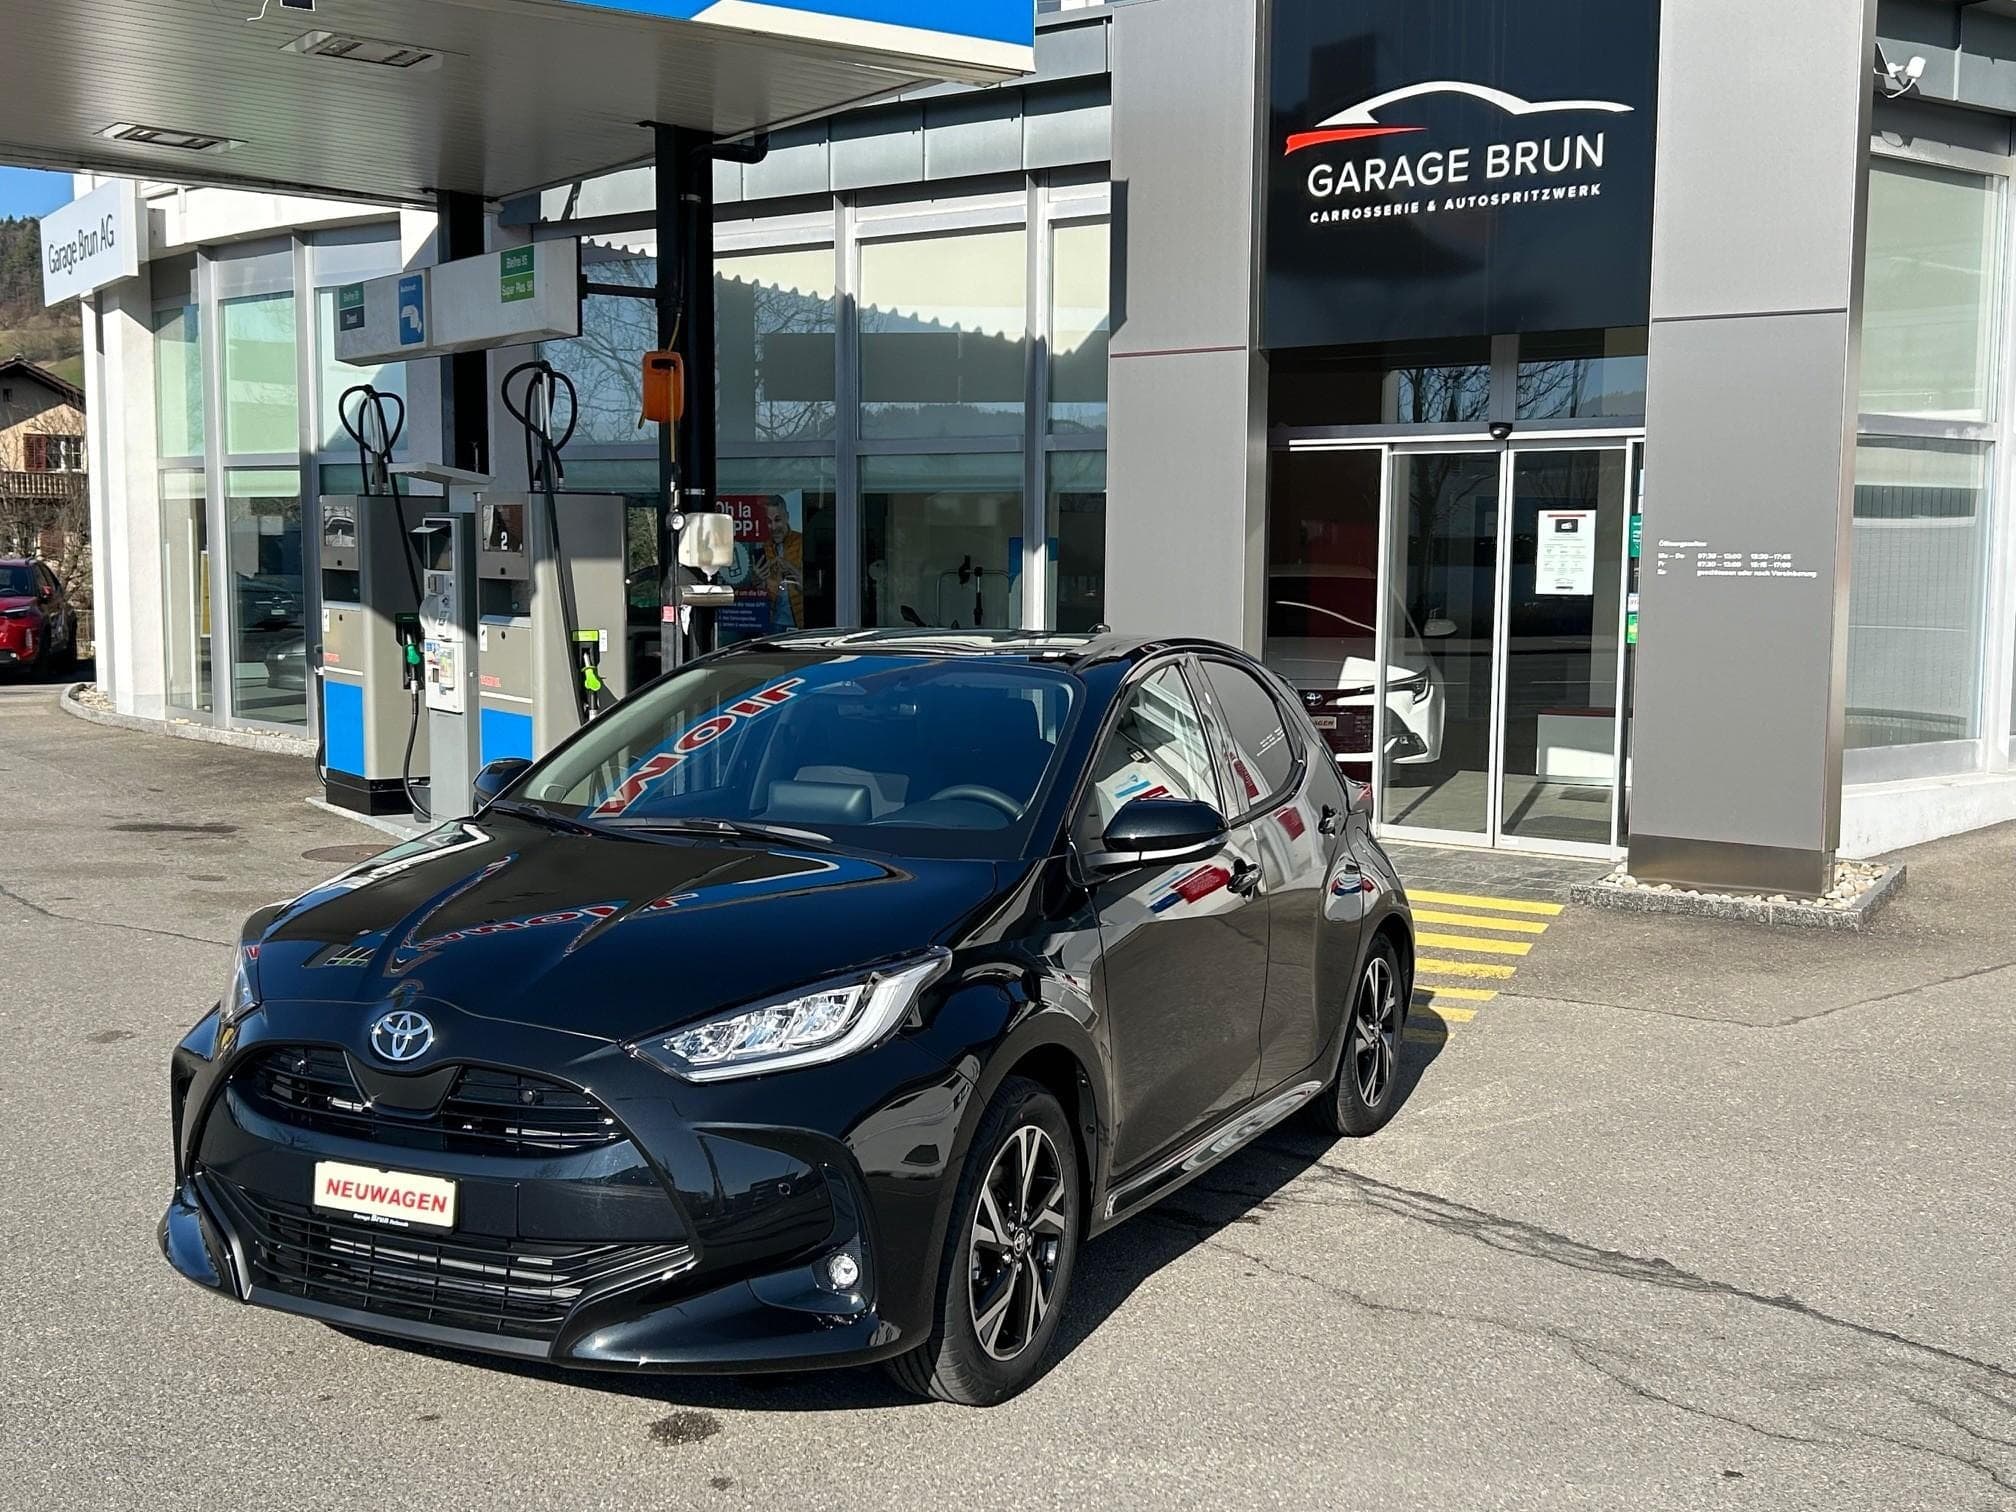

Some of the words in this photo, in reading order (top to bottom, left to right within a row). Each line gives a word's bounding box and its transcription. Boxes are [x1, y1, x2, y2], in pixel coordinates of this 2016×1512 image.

[1307, 148, 1470, 198] GARAGE
[1486, 132, 1604, 179] BRUN
[1309, 202, 1420, 224] CARROSSERIE
[1427, 200, 1437, 212] &
[1444, 183, 1602, 211] AUTOSPRITZWERK
[48, 241, 78, 275] Garage
[78, 229, 99, 261] Brun
[100, 213, 115, 252] AG
[501, 531, 508, 550] 2
[732, 520, 760, 537] PP!
[325, 1177, 448, 1213] NEUWAGEN
